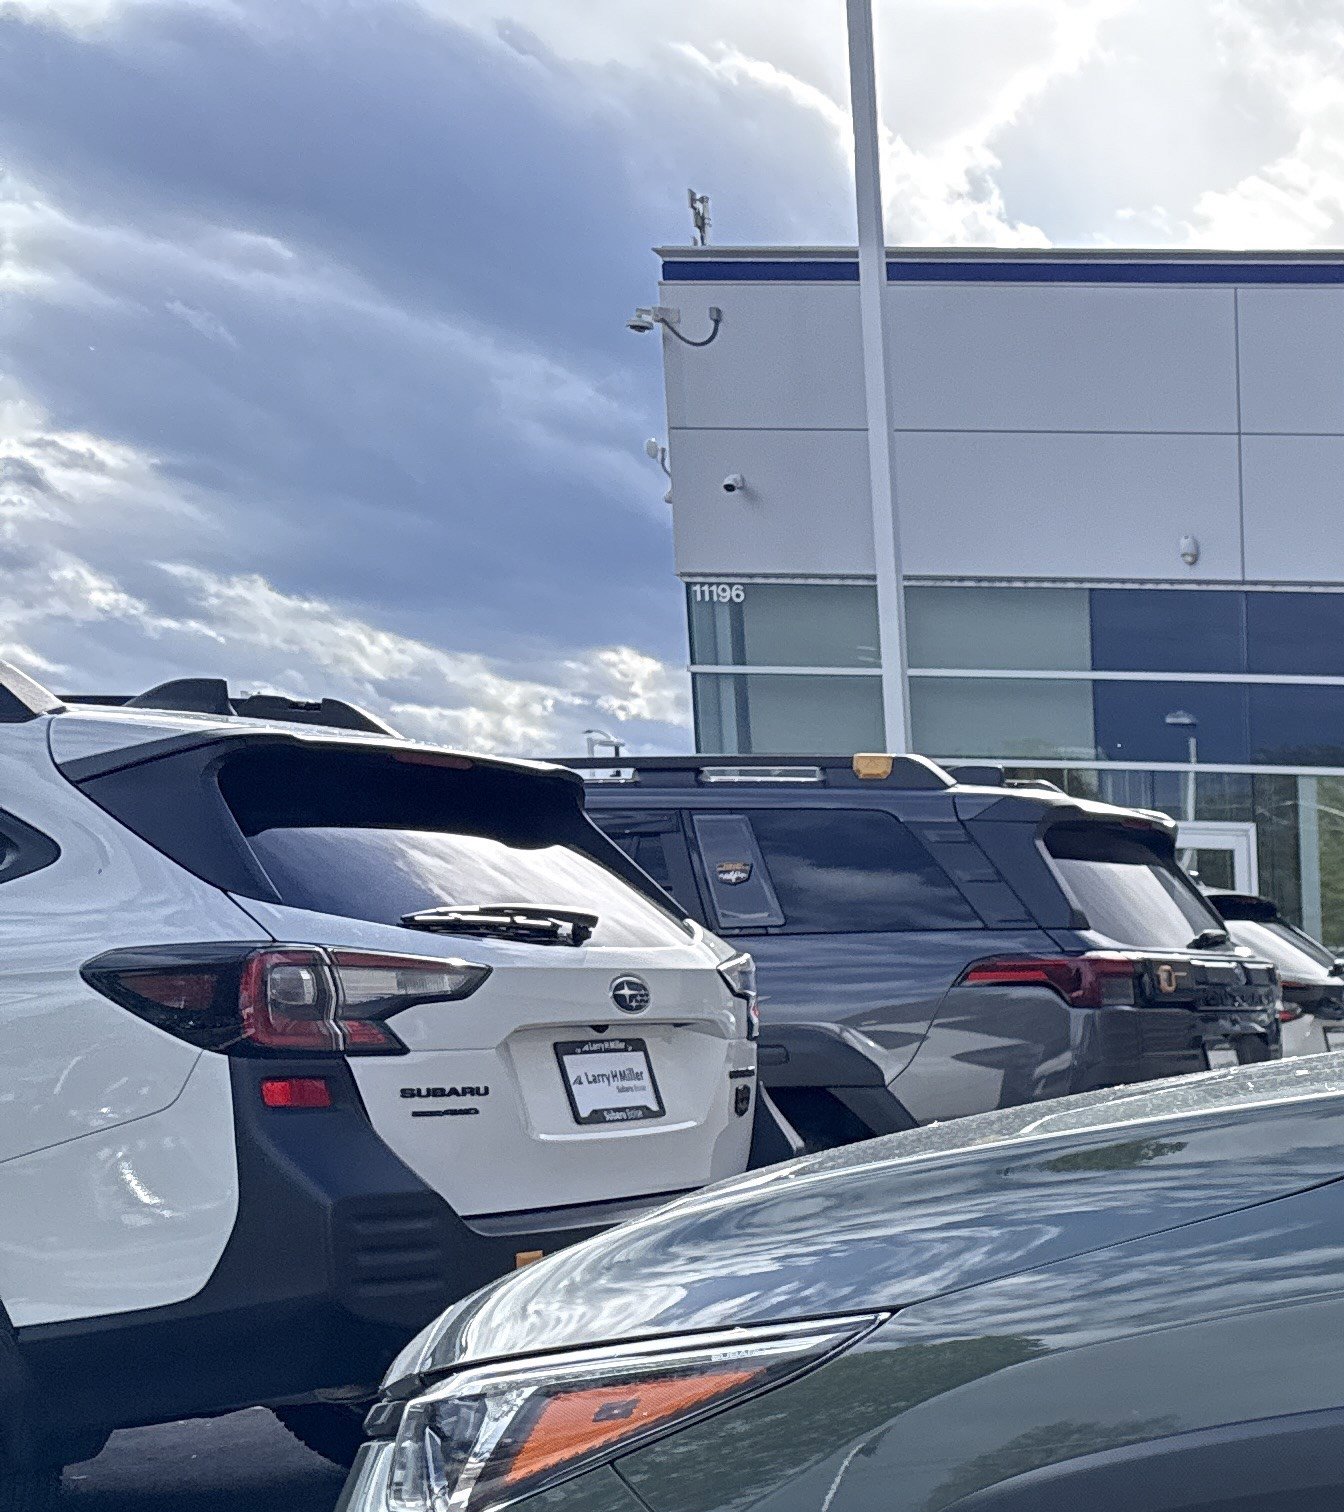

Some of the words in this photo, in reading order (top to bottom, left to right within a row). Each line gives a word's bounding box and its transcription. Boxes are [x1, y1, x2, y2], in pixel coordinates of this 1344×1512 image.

[692, 584, 745, 602] 11196
[583, 1072, 611, 1087] Larry
[610, 1070, 619, 1083] H
[619, 1067, 644, 1081] Miller
[400, 1086, 490, 1098] SUBARU
